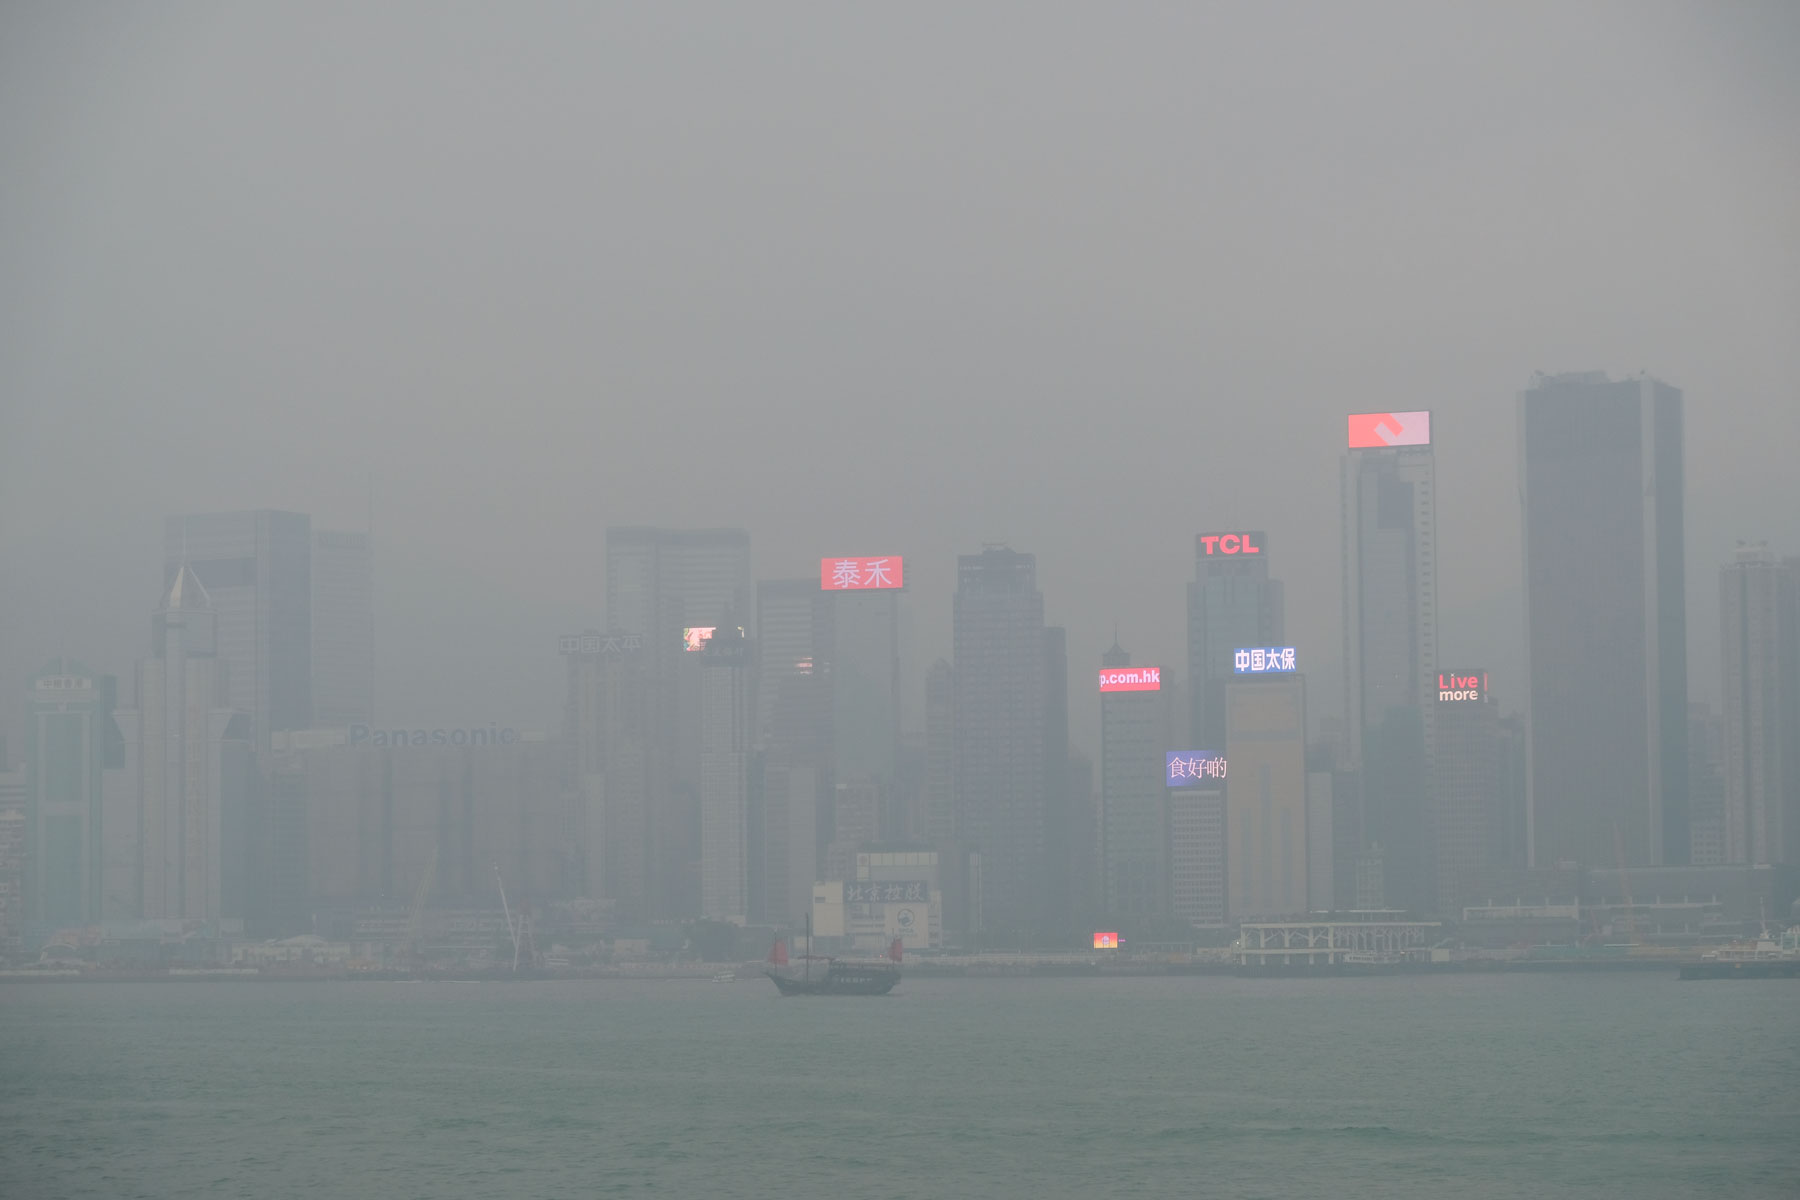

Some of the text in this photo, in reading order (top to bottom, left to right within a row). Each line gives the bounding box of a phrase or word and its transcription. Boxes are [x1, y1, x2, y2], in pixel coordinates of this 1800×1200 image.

[1200, 534, 1259, 554] TCL
[832, 559, 892, 588] 泰禾
[1235, 648, 1295, 672] 中国太保
[1099, 670, 1160, 688] p.com.hk
[1439, 673, 1478, 689] Live
[1439, 690, 1478, 701] more
[350, 721, 514, 746] Panasonic
[1167, 757, 1227, 779] 食好啲
